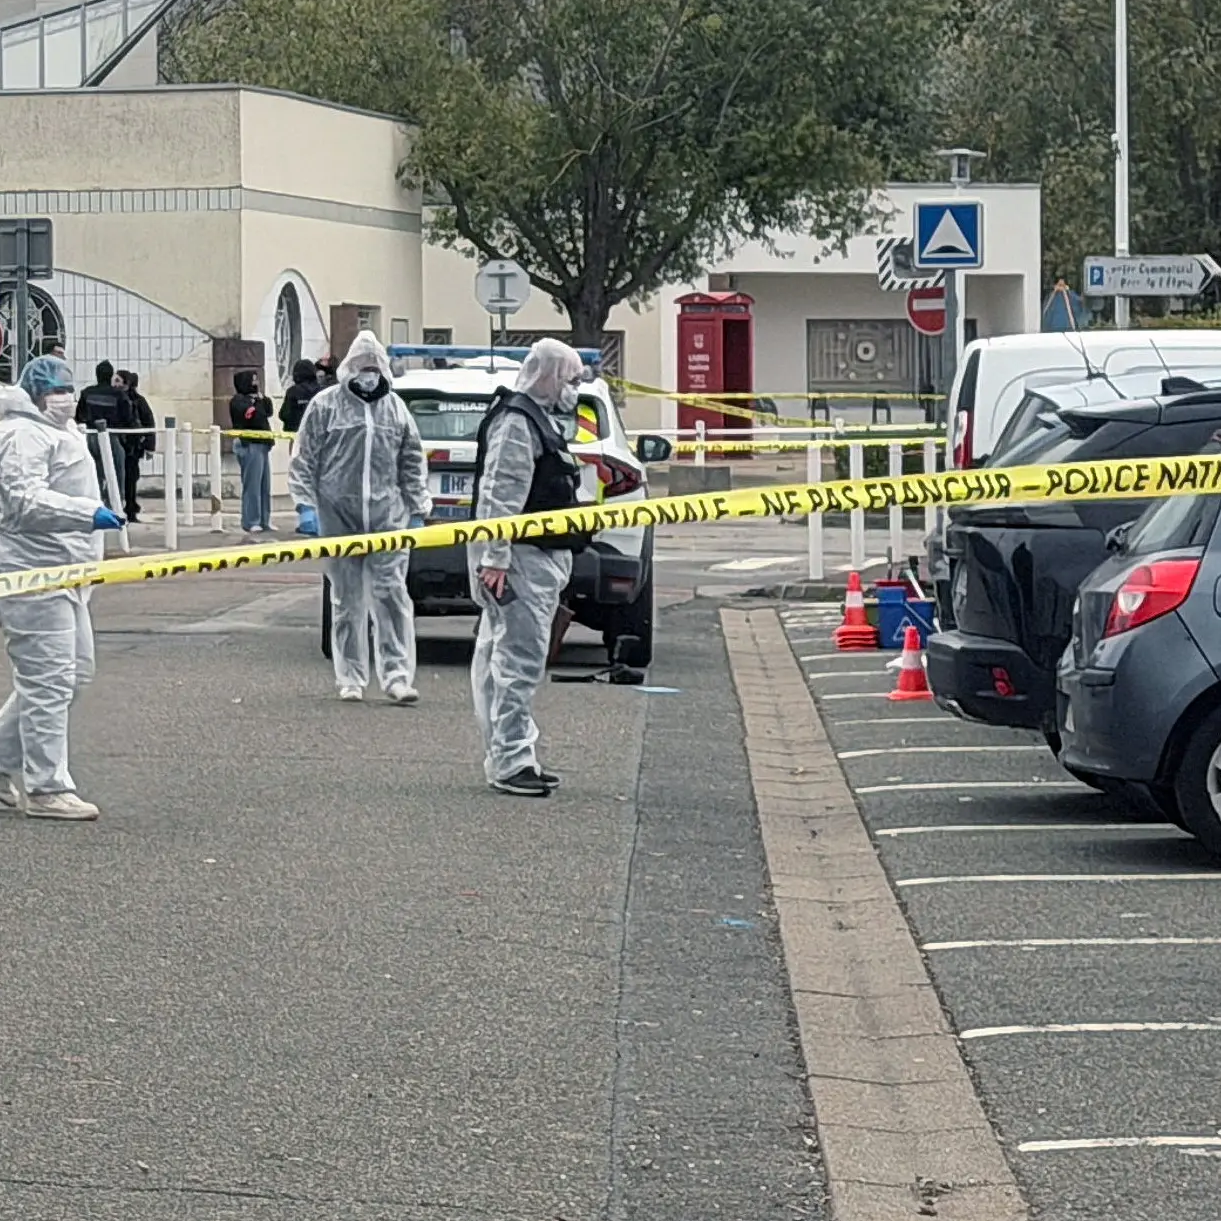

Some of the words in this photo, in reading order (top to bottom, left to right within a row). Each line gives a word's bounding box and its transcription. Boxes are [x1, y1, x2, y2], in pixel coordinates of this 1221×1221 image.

[565, 499, 729, 535] NATIONALE
[760, 491, 802, 516] NE
[806, 485, 859, 513] PAS
[863, 473, 1012, 509] FRANCHIR
[1045, 464, 1151, 496] POLICE
